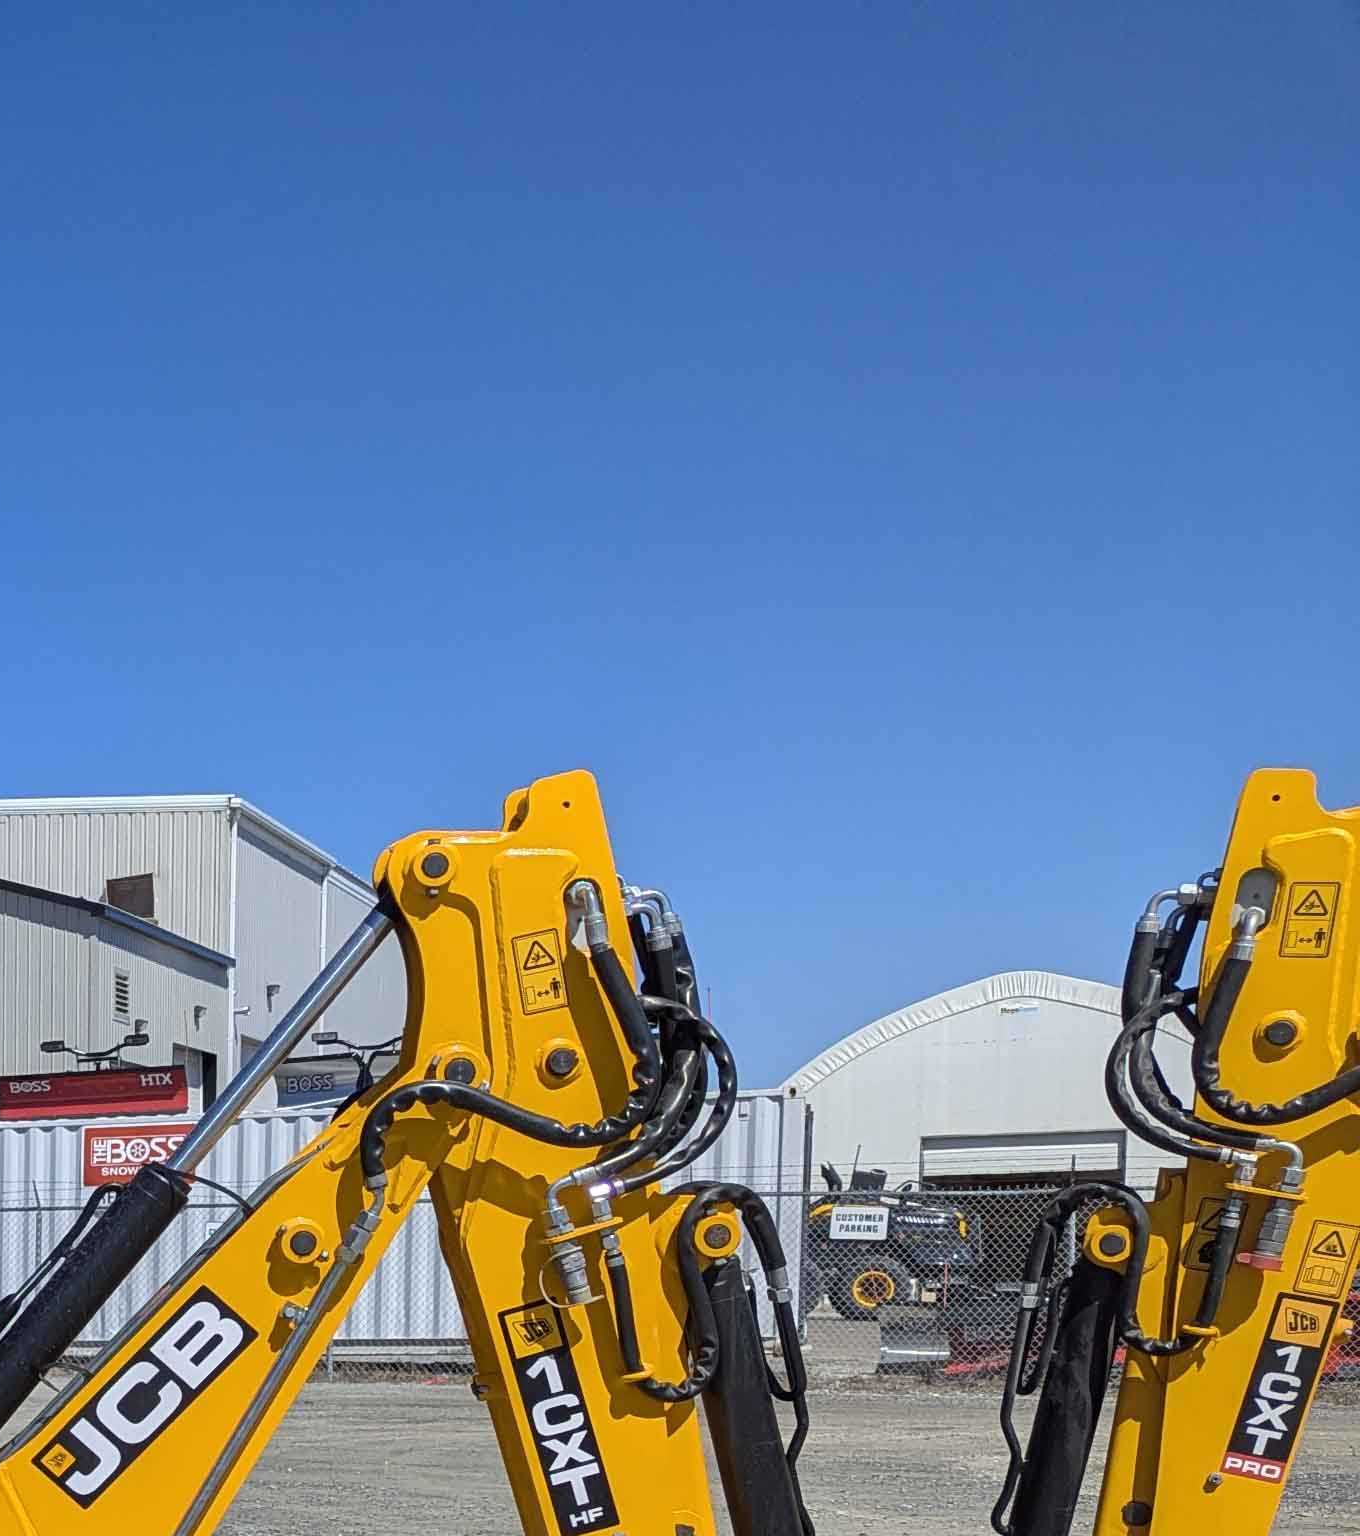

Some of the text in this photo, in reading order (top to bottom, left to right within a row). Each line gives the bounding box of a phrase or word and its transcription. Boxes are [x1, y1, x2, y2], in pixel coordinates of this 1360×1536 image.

[10, 1080, 51, 1093] BOSS
[140, 1073, 173, 1086] HTX
[287, 1073, 334, 1093] BOSS
[101, 1166, 141, 1176] SNOW
[835, 1213, 884, 1222] CUSTOMER
[838, 1223, 879, 1233] PARKING
[519, 1319, 550, 1343] JCB
[1287, 1311, 1318, 1332] JCB
[65, 1301, 244, 1495] JCB
[1245, 1345, 1303, 1456] 1CXT
[526, 1354, 601, 1507] 1CXT
[1224, 1457, 1281, 1479] PRO
[569, 1507, 604, 1528] HF
